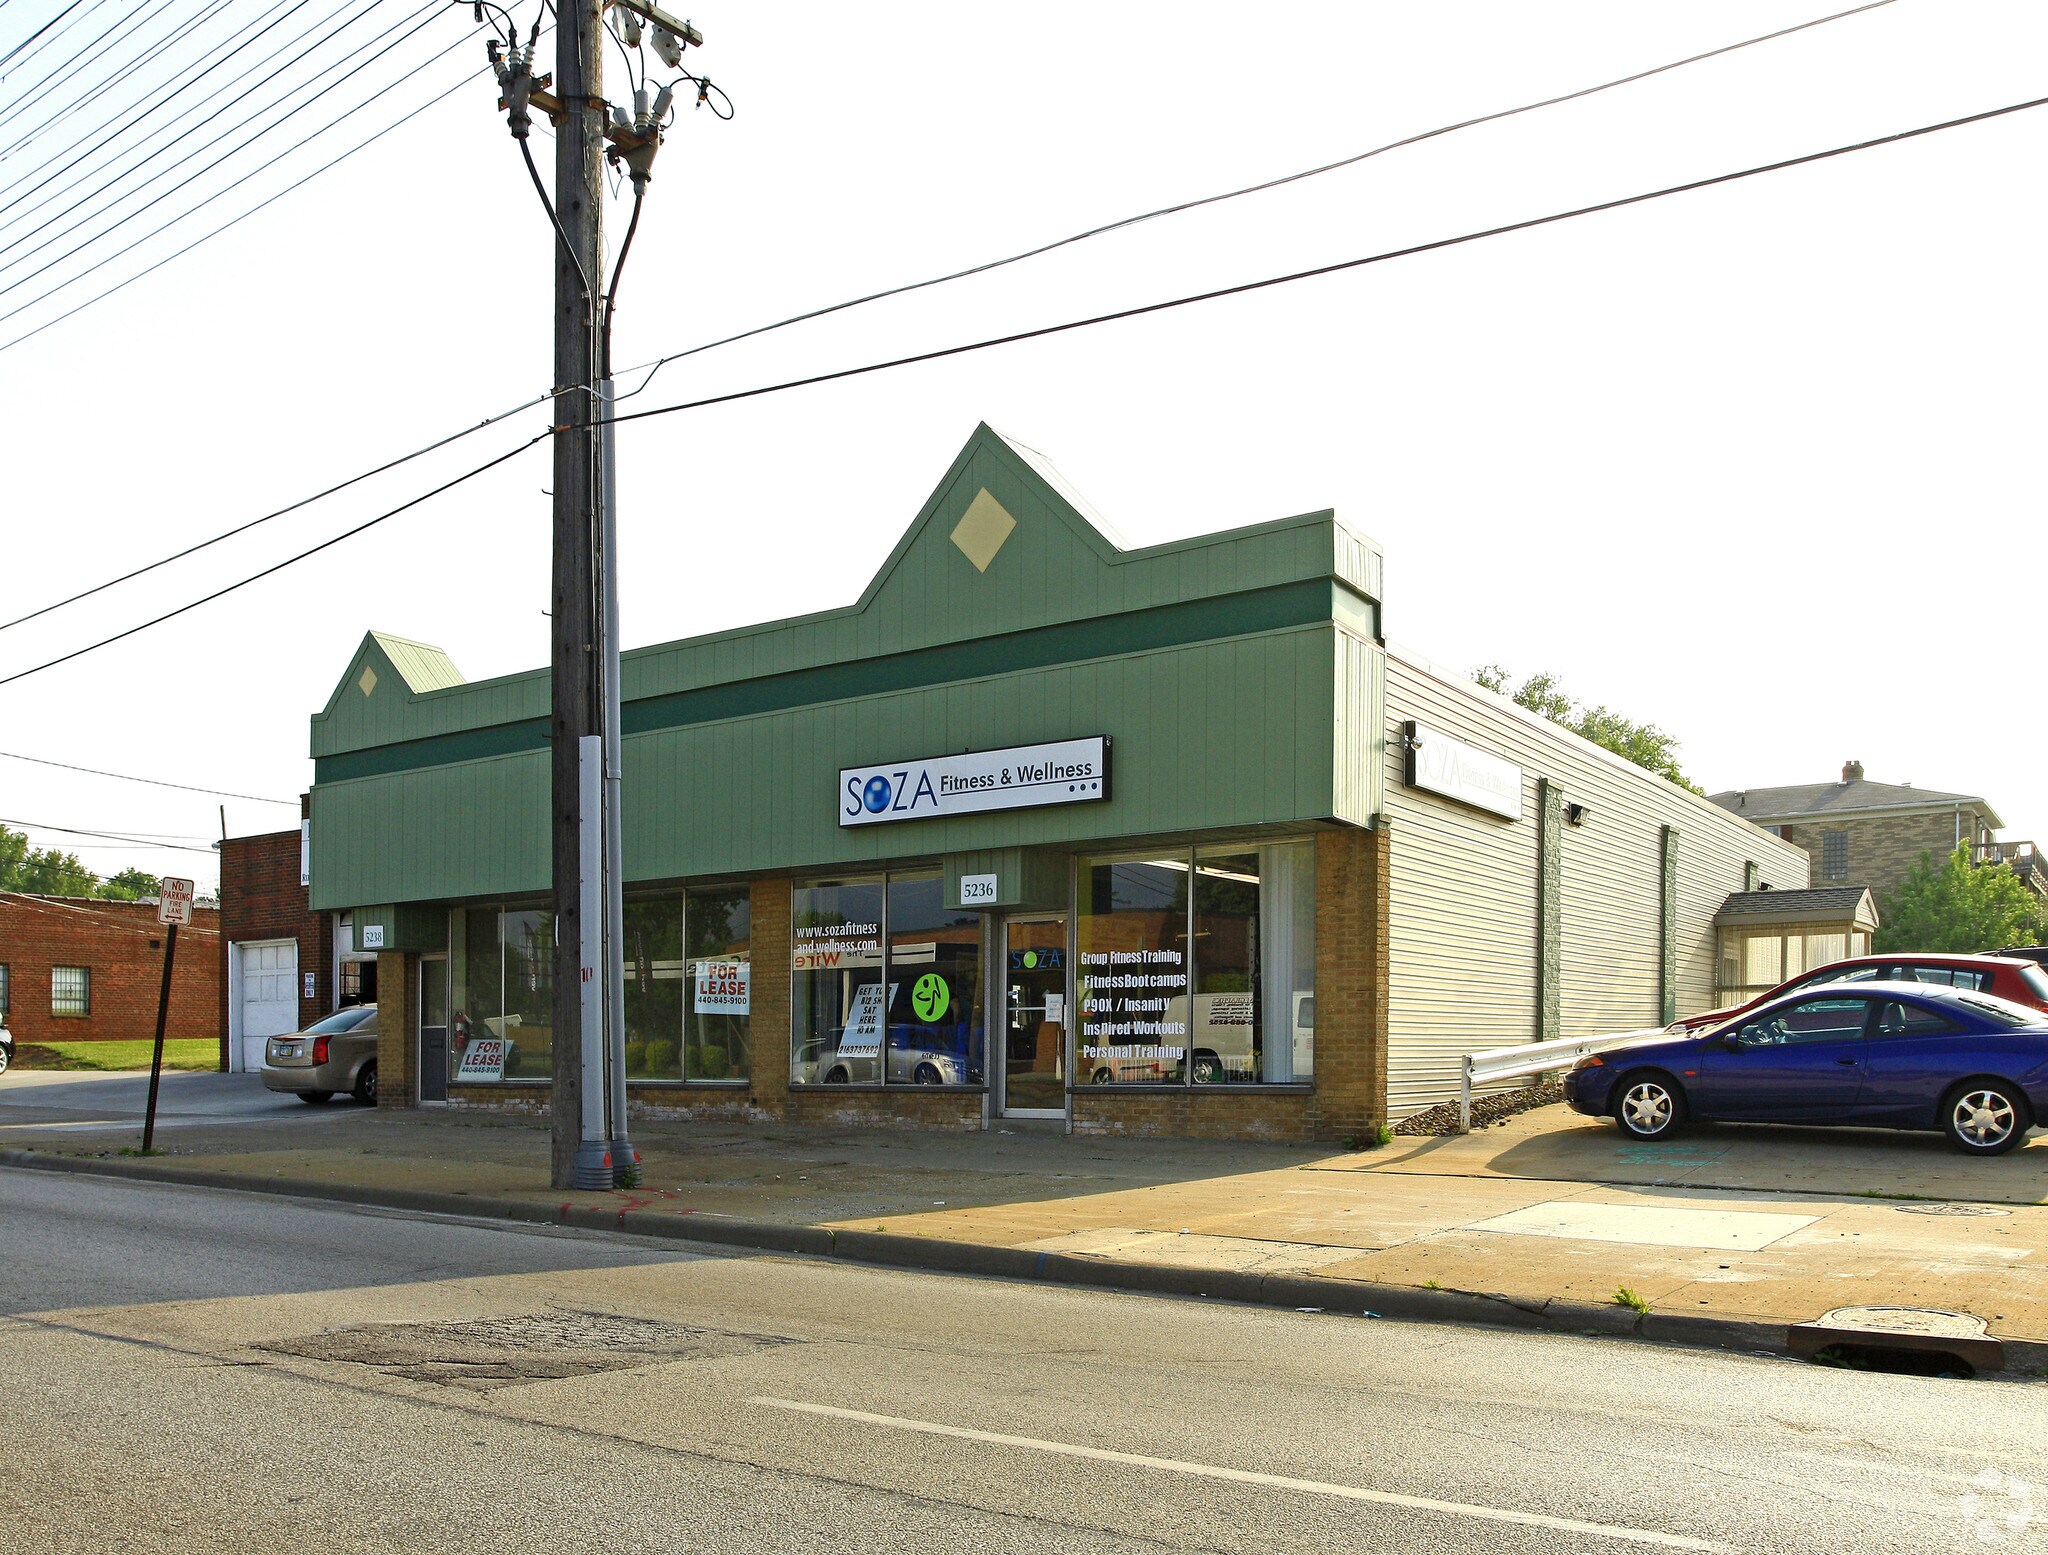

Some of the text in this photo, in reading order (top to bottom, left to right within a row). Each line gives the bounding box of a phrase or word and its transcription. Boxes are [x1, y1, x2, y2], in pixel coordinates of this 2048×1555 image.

[845, 761, 1093, 817] SOZA Fitness & Wellness
[172, 881, 184, 891] NO
[964, 882, 993, 897] 5236
[163, 890, 190, 902] PARKING
[796, 921, 877, 938] www.sozafitness
[365, 931, 382, 942] 5238
[1011, 949, 1060, 969] SOZA
[1081, 949, 1181, 966] Group Fitness Training
[709, 966, 737, 979] FOR
[699, 981, 746, 995] LEASE
[1084, 975, 1124, 989] Fitness
[859, 987, 872, 996] GET
[697, 997, 747, 1005] 440-845-9100
[1083, 997, 1171, 1013] P90X / Insanity
[863, 1006, 876, 1014] SAT
[859, 1015, 876, 1024] HERE
[865, 1026, 876, 1034] AM
[1083, 1020, 1185, 1036] Inspired Workouts
[476, 1041, 501, 1053] FOR
[1083, 1044, 1184, 1060] Personal Training
[465, 1054, 503, 1066] LEASE
